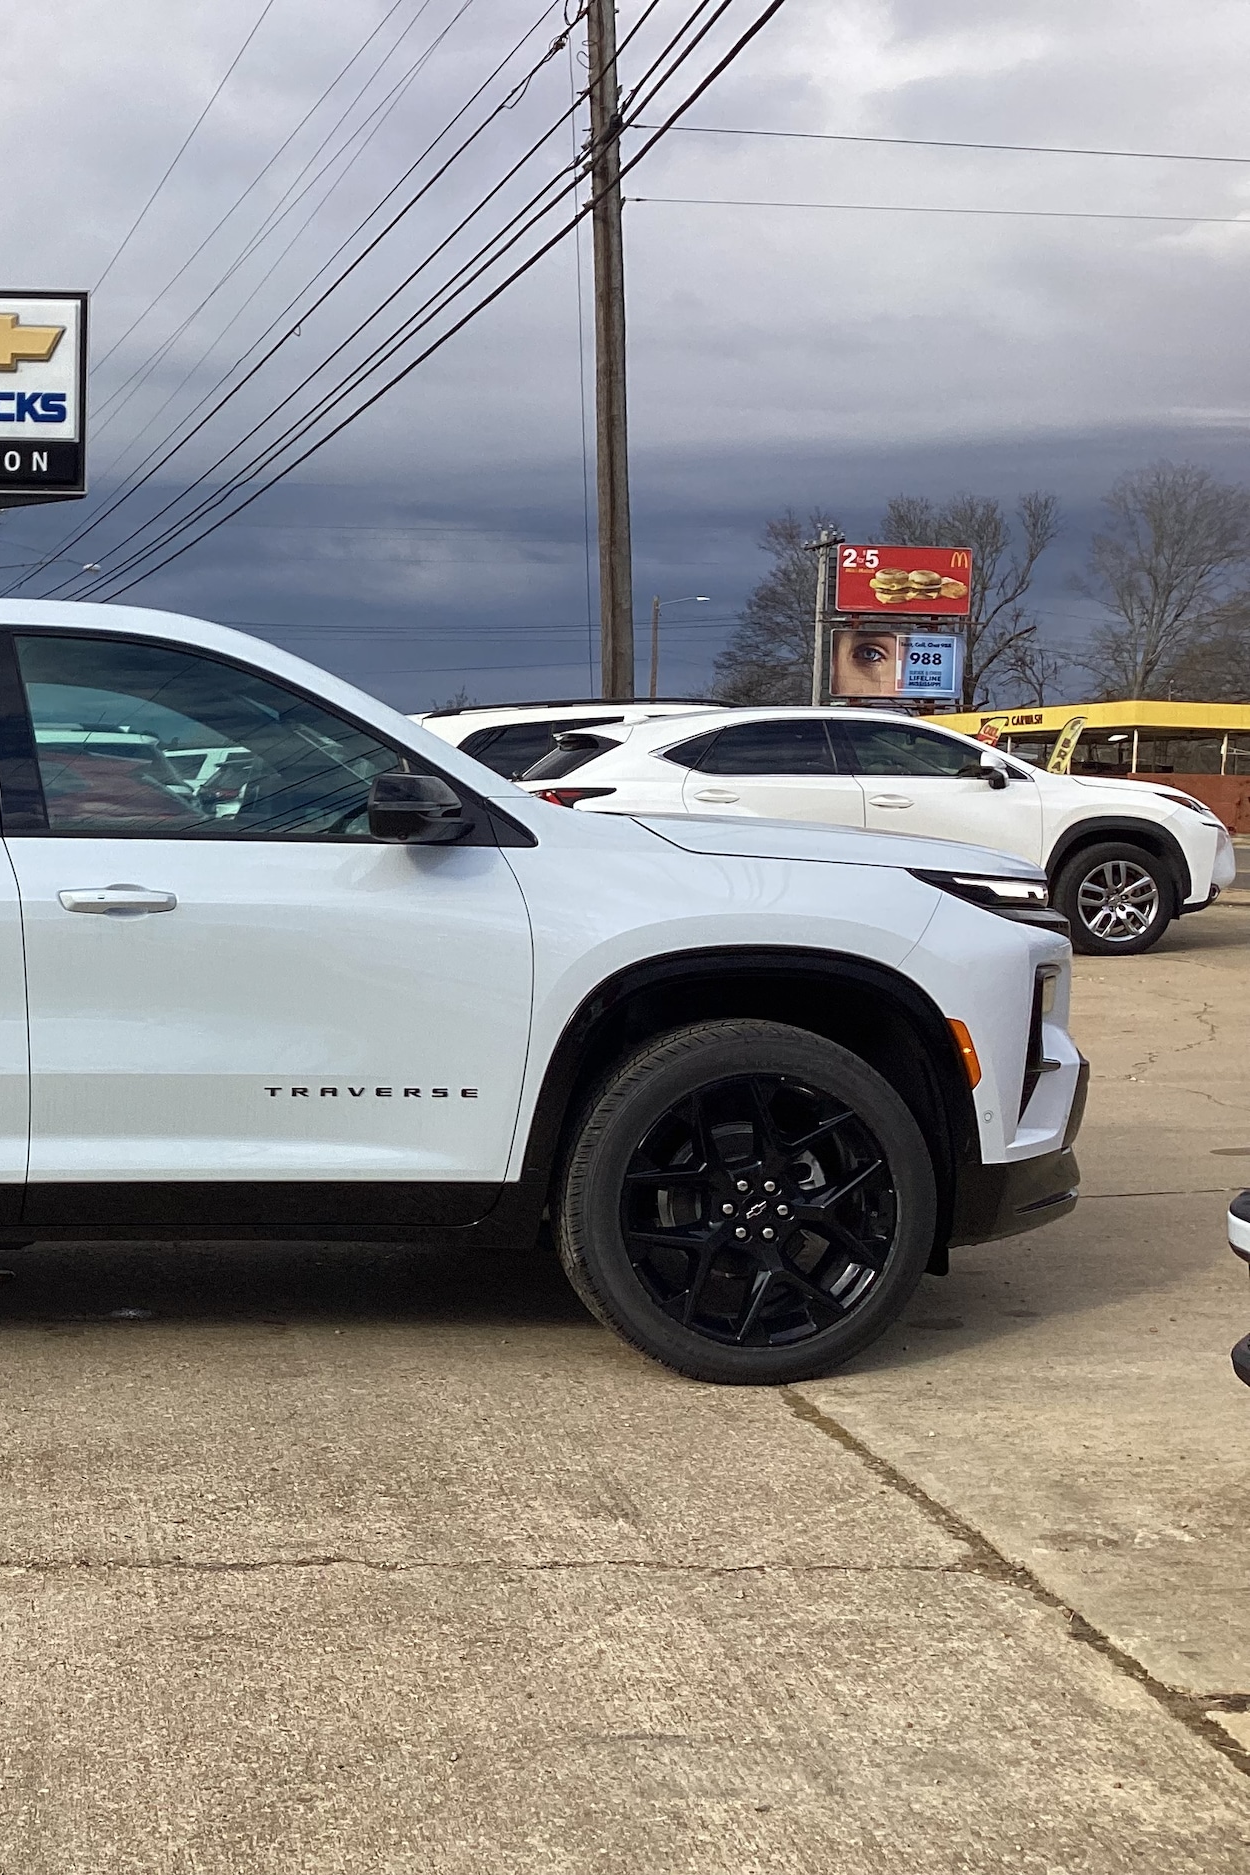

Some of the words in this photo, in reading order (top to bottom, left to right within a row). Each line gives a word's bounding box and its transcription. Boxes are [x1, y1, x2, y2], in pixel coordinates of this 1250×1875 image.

[842, 548, 858, 568] 2
[909, 652, 942, 666] 988
[1011, 714, 1043, 726] CARWASH
[1050, 737, 1071, 774] BRA
[264, 1087, 479, 1099] TRAVERSE
